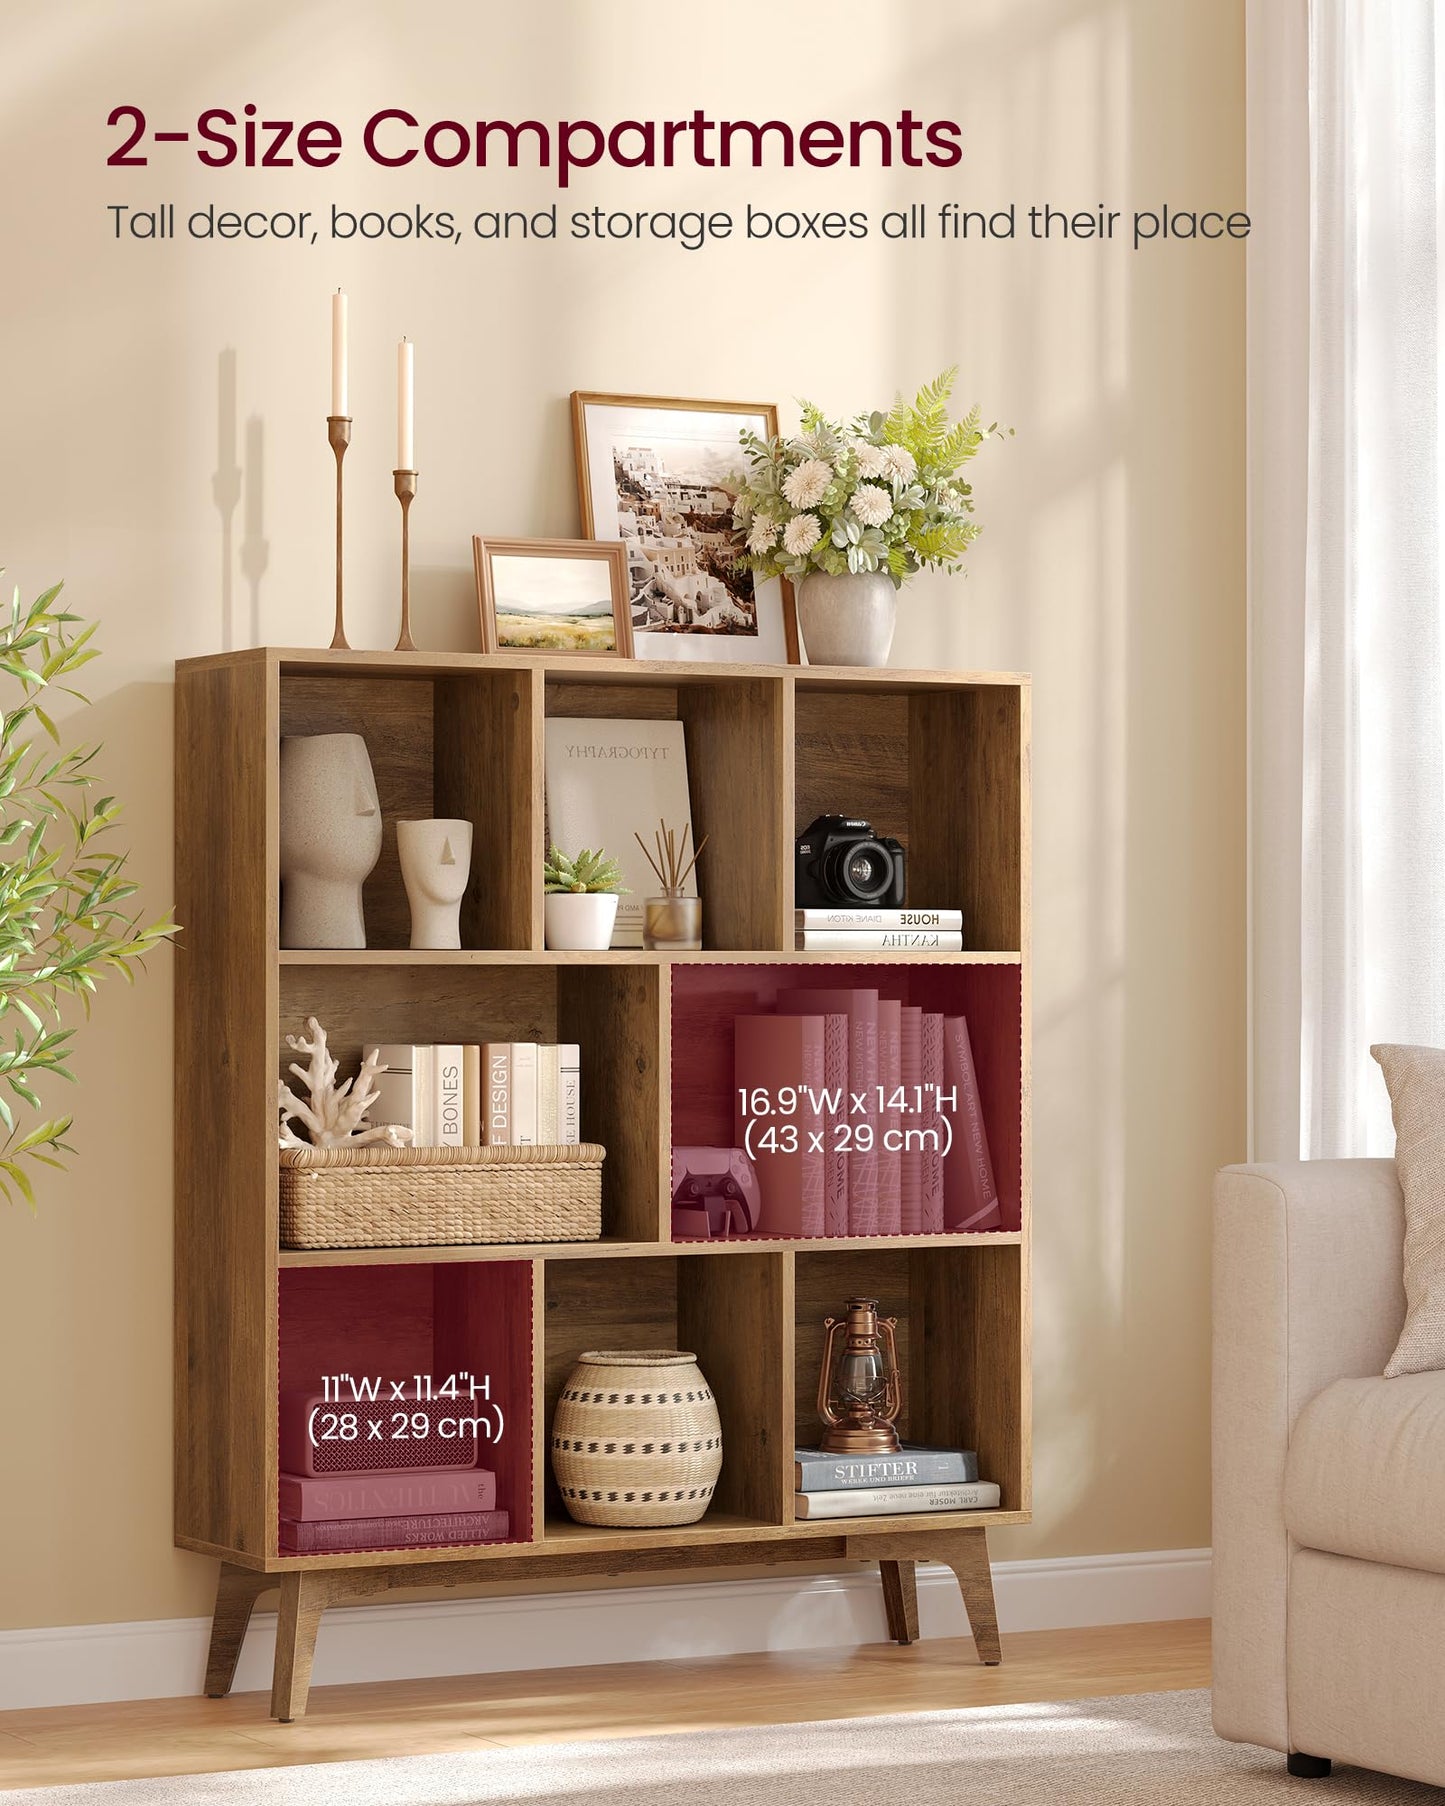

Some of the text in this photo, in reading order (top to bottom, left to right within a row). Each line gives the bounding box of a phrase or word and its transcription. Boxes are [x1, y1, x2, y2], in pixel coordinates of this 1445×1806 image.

[442, 1066, 458, 1135] BONES
[492, 1055, 507, 1128] DESIGN
[566, 1080, 576, 1126] HOUSE
[954, 1033, 972, 1090] SYMBOL
[976, 1157, 992, 1200] HOME
[834, 1461, 918, 1479] STIFTER
[929, 1496, 979, 1506] CARL MOSER
[404, 1515, 490, 1530] ARCHITECTURE
[405, 1529, 490, 1543] ALLIED WORKS
